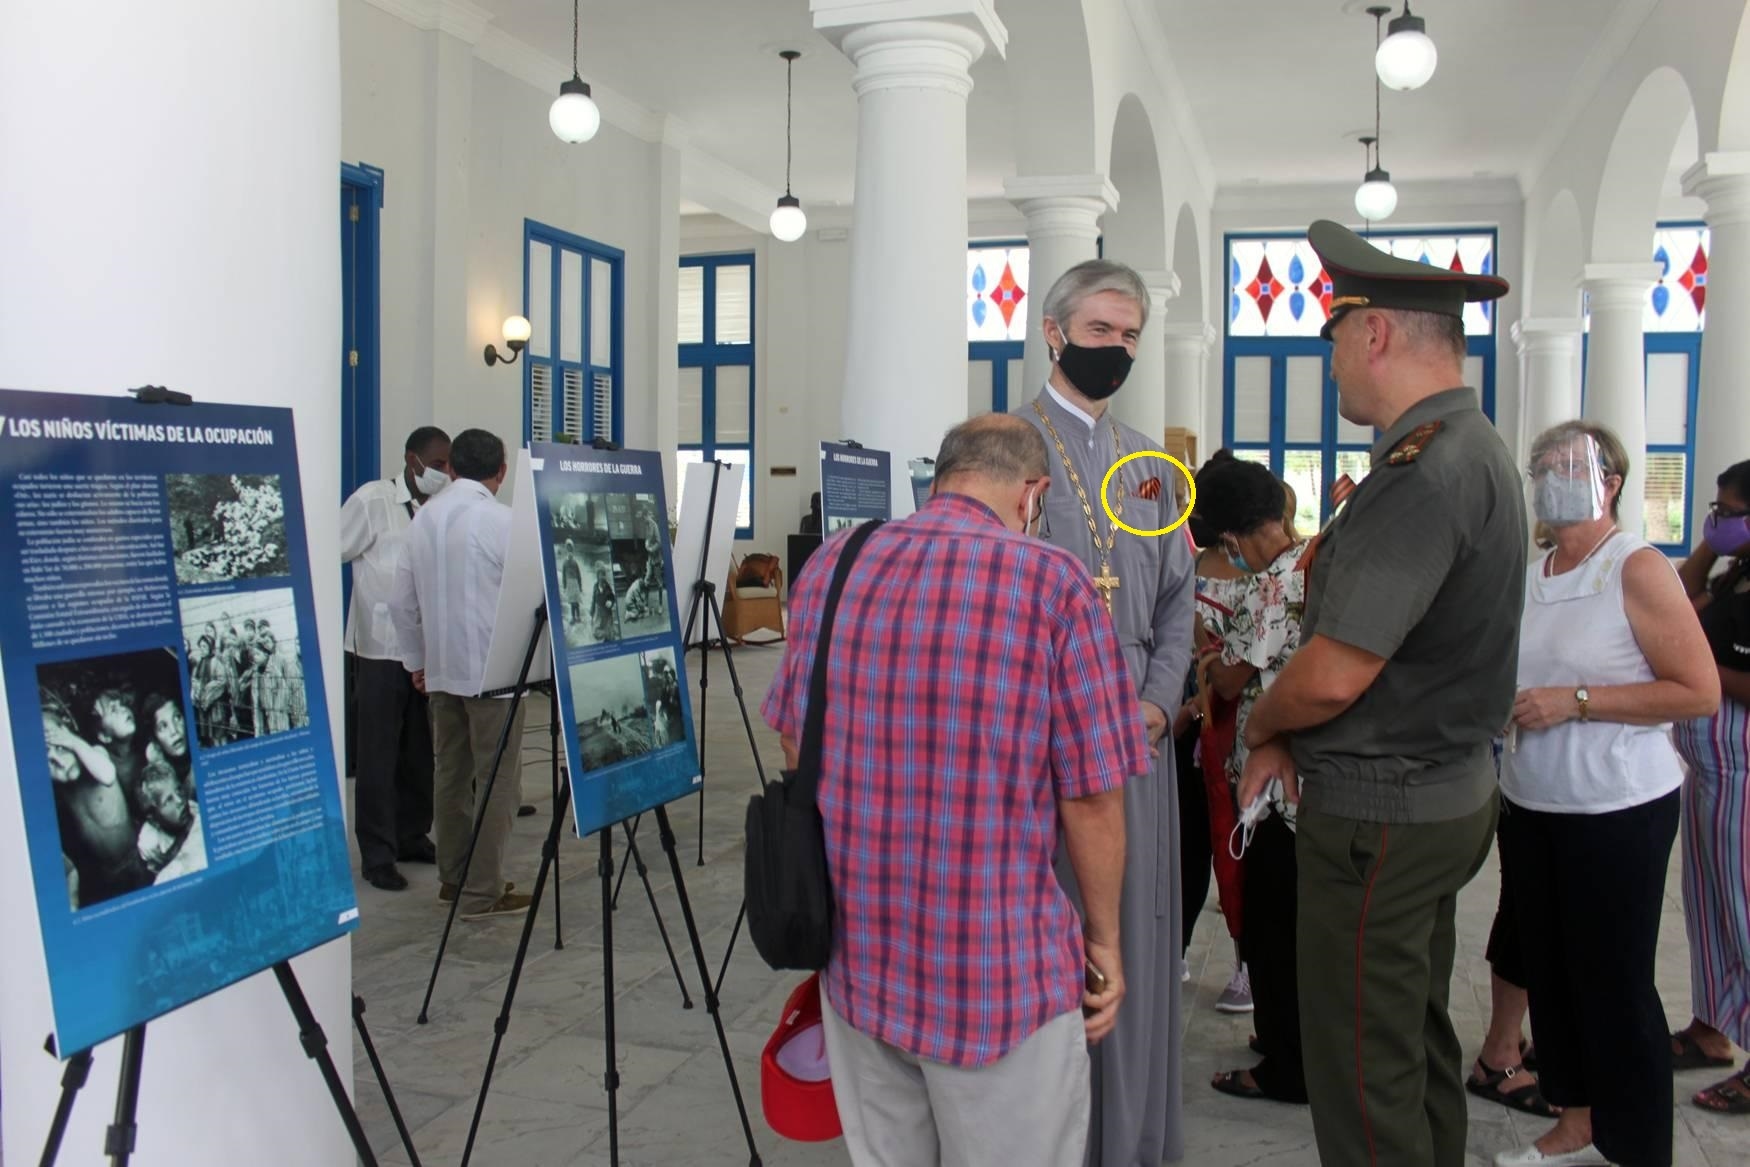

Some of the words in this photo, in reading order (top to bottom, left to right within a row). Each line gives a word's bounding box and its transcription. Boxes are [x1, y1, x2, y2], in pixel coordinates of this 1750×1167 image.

[9, 418, 41, 438] LOS
[43, 417, 94, 440] NIÑOS
[94, 419, 166, 442] VÍCTIMAS
[166, 425, 185, 442] DE
[186, 427, 204, 443] LA
[204, 427, 273, 445] OCUPACIÓN
[560, 460, 571, 472] LOS
[603, 463, 612, 474] DE
[612, 464, 619, 474] LA
[620, 464, 642, 475] GUERRA
